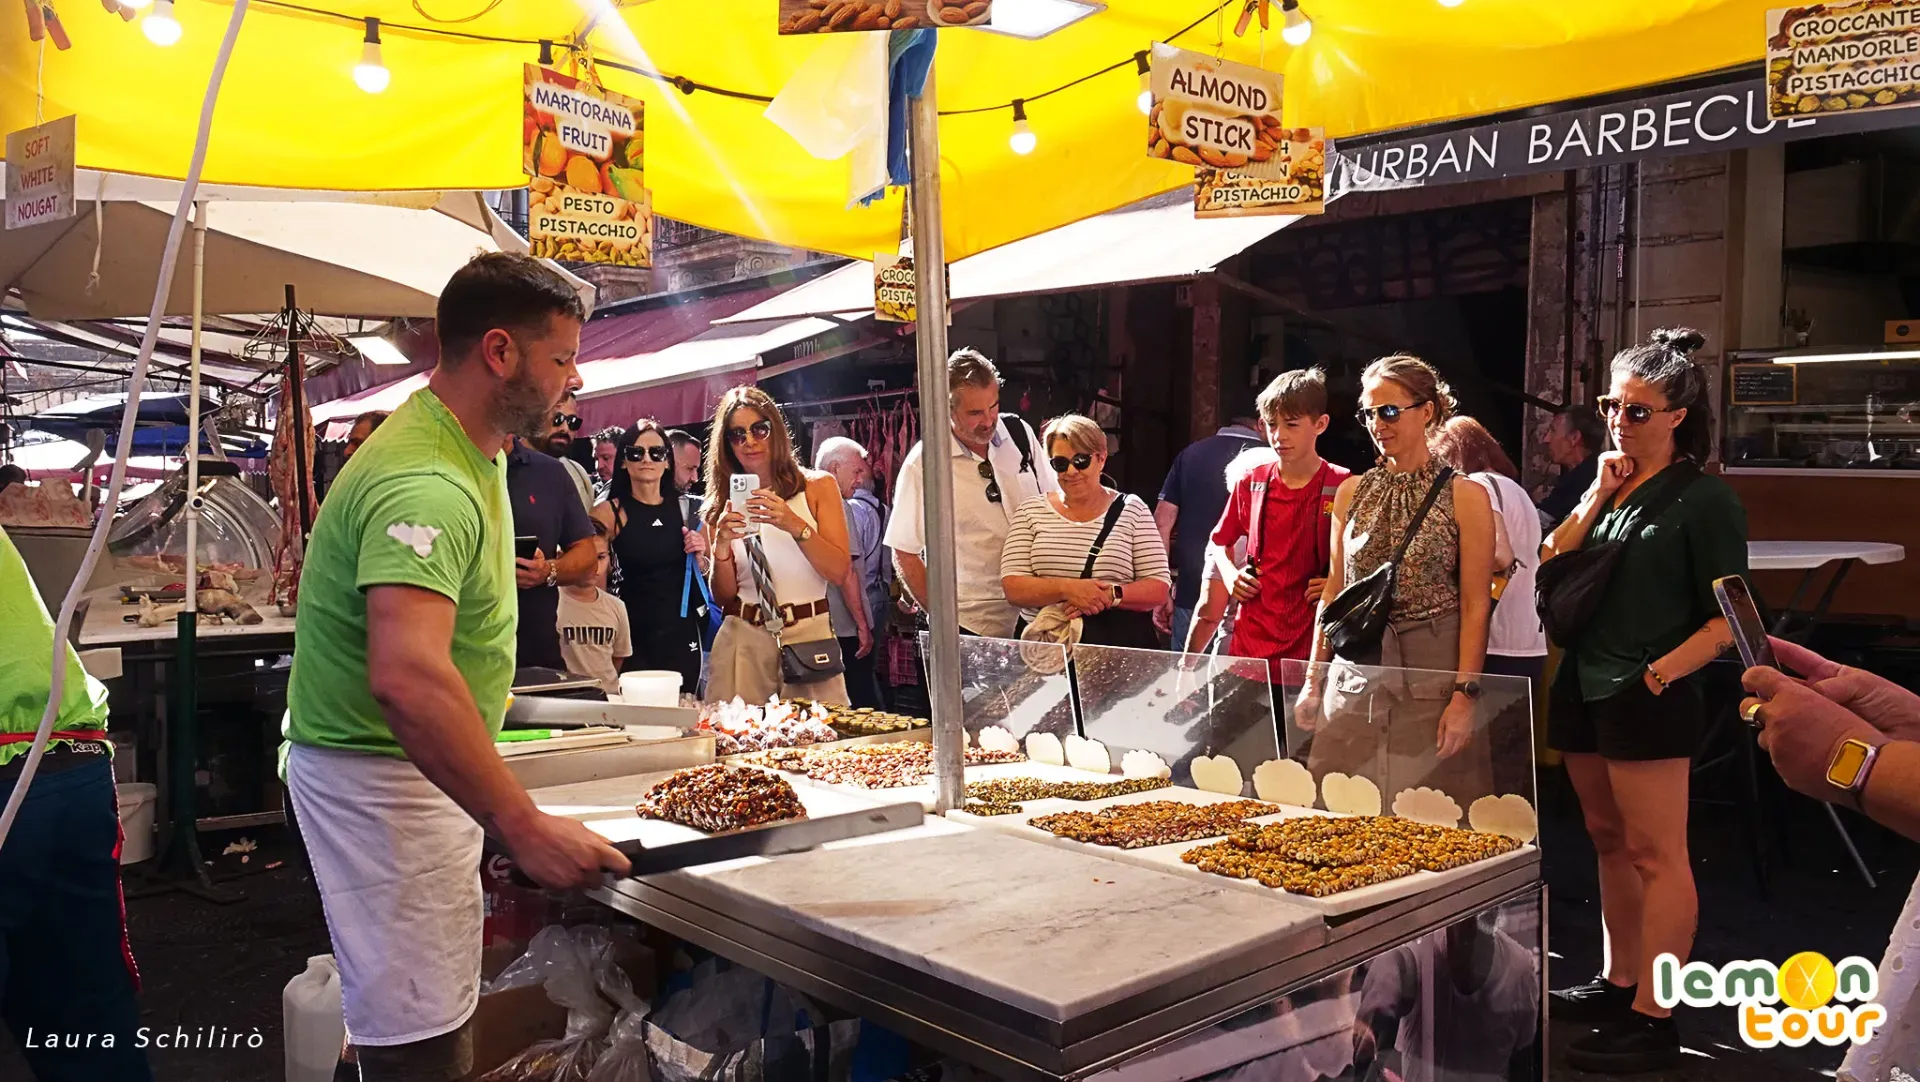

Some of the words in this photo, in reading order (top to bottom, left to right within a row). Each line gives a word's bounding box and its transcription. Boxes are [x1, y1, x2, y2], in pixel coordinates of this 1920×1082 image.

[1793, 8, 1920, 38] CROCCANTE
[1797, 36, 1918, 65] MANDORLE
[1170, 67, 1267, 111] ALMOND
[1791, 64, 1920, 93] PISTACCHIO
[535, 87, 632, 130] MARTORANA
[25, 135, 50, 159] SOFT
[562, 125, 608, 152] FRUIT
[1186, 115, 1252, 151] STICK
[1352, 131, 1499, 185] URBAN
[1527, 94, 1817, 164] BARBECU
[21, 165, 54, 191] WHITE
[18, 195, 57, 221] NOUGAT
[564, 197, 615, 215] PESTO
[1213, 186, 1300, 203] PISTACHIO
[540, 217, 637, 239] PISTACCHIO
